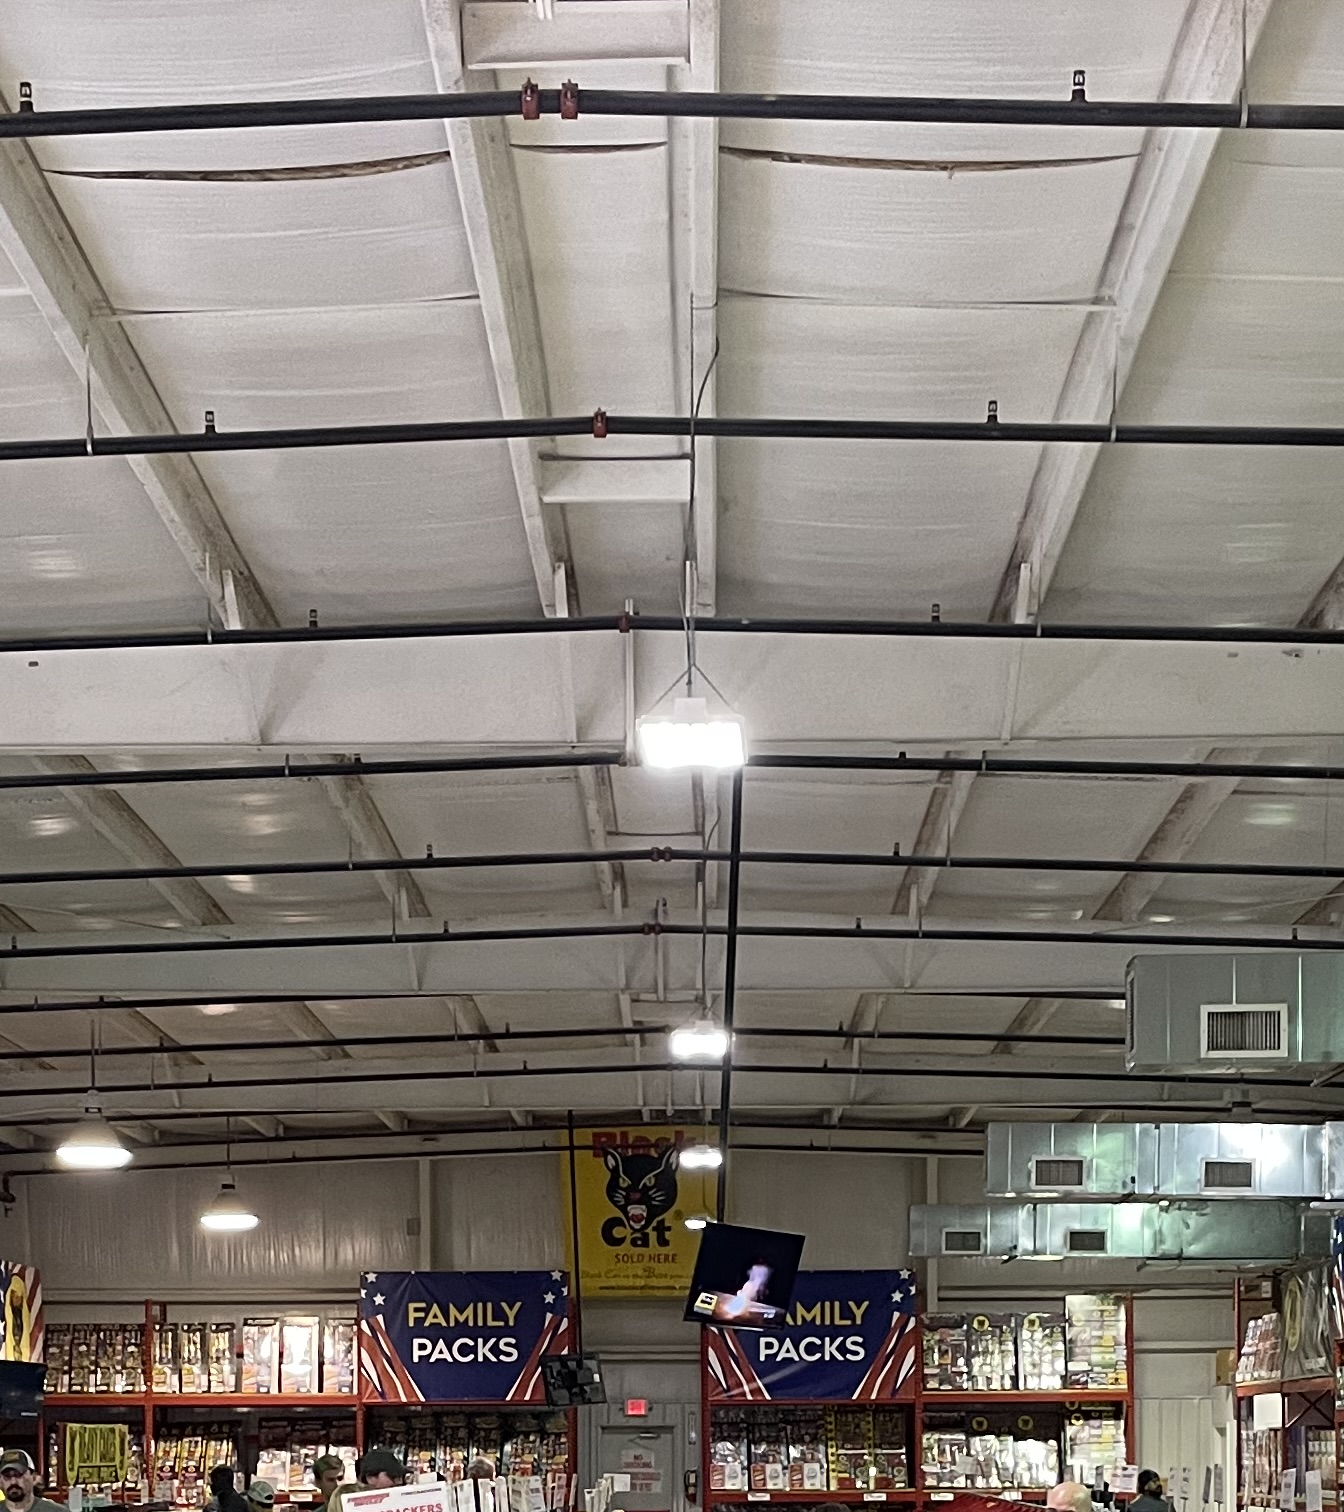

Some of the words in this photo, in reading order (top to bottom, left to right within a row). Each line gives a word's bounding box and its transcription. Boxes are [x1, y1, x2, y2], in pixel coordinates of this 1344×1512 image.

[601, 1216, 672, 1249] Cat
[614, 1253, 645, 1265] SOLD
[648, 1253, 678, 1265] HERE
[408, 1301, 523, 1327] FAMILY
[786, 1300, 870, 1326] MILY
[412, 1337, 519, 1363] PACKS
[759, 1336, 866, 1362] PACKS
